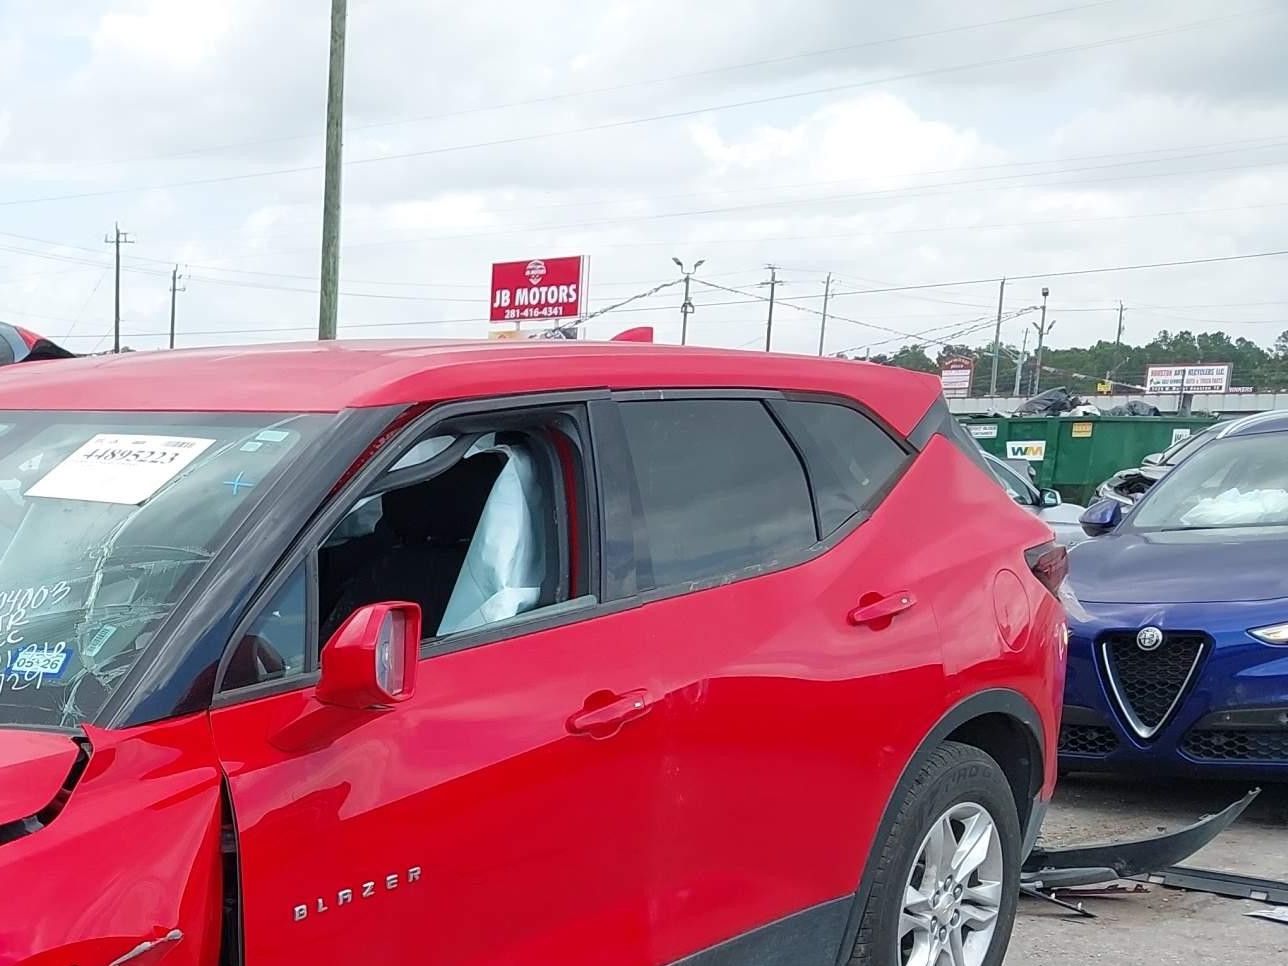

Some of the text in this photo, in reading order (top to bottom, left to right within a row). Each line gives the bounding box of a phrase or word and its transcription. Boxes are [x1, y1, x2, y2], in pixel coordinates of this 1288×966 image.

[493, 284, 577, 308] JB MOTORS
[504, 306, 564, 319] 281-416-4341
[1011, 446, 1043, 456] WM
[293, 866, 421, 922] BLAZER
